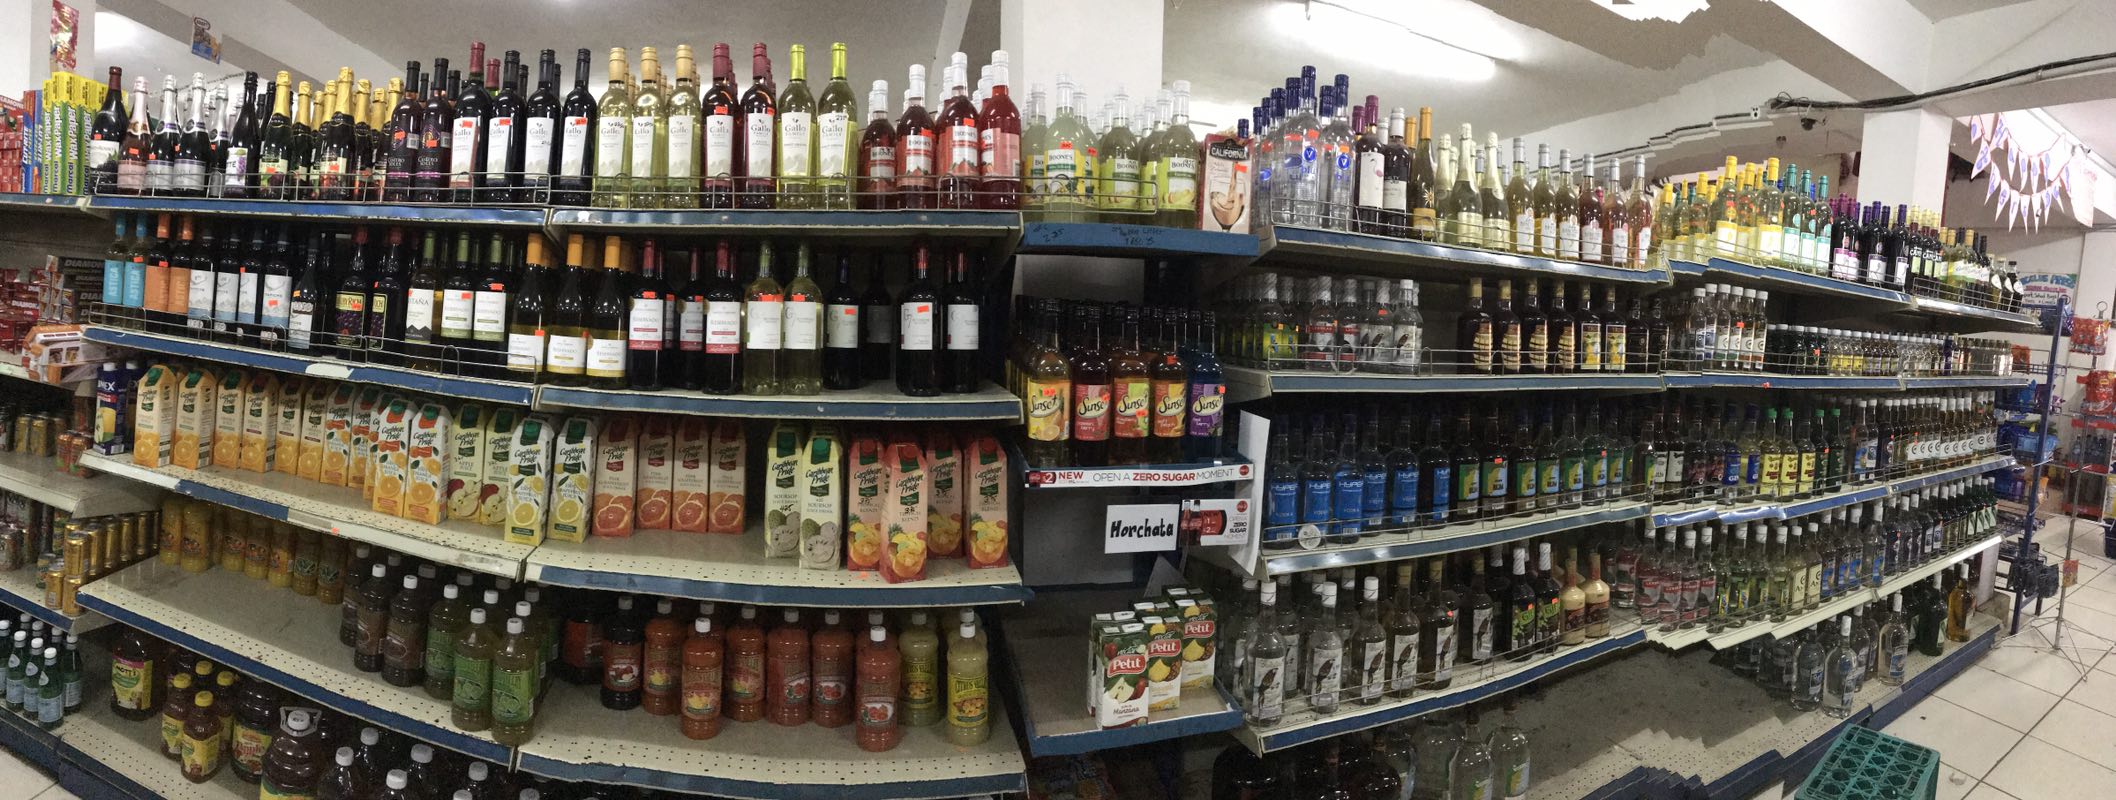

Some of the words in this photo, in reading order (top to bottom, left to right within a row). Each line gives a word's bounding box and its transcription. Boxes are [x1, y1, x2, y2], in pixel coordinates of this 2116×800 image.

[751, 124, 771, 133] Gallo
[785, 124, 807, 132] Gallo
[822, 125, 843, 134] Gallo
[1211, 147, 1248, 158] CALIFORNIA
[1030, 394, 1058, 414] Sunset
[413, 432, 437, 440] Caribbean
[455, 432, 480, 440] Caribbean
[460, 438, 476, 446] Pride
[514, 448, 541, 458] Caribbean
[560, 447, 586, 456] Caribbean
[603, 446, 629, 455] Caribbean
[520, 456, 537, 464] Pride
[565, 454, 582, 462] Pride
[608, 453, 625, 461] Pride
[772, 460, 798, 471] Caribbean
[930, 461, 957, 473] Caribbean
[777, 468, 795, 477] Pride
[806, 468, 833, 479] Caribbean
[854, 467, 883, 480] Caribbean
[936, 470, 953, 479] Pride
[975, 466, 1003, 480] Caribbean
[1059, 472, 1084, 480] NEW
[1093, 473, 1121, 482] OPEN
[1123, 472, 1131, 481] A
[1133, 473, 1161, 481] ZERO
[1162, 473, 1196, 481] SUGAR
[1197, 468, 1234, 480] MOMENT
[811, 477, 830, 485] Pride
[860, 477, 879, 486] Pride
[896, 474, 924, 488] Caribbean
[981, 475, 999, 485] Pride
[902, 484, 920, 494] Pride
[1110, 519, 1174, 539] Horchata
[1184, 623, 1211, 634] Petit
[1150, 642, 1178, 654] Petit
[1113, 658, 1141, 670] Petit
[115, 666, 137, 677] MOTT'S
